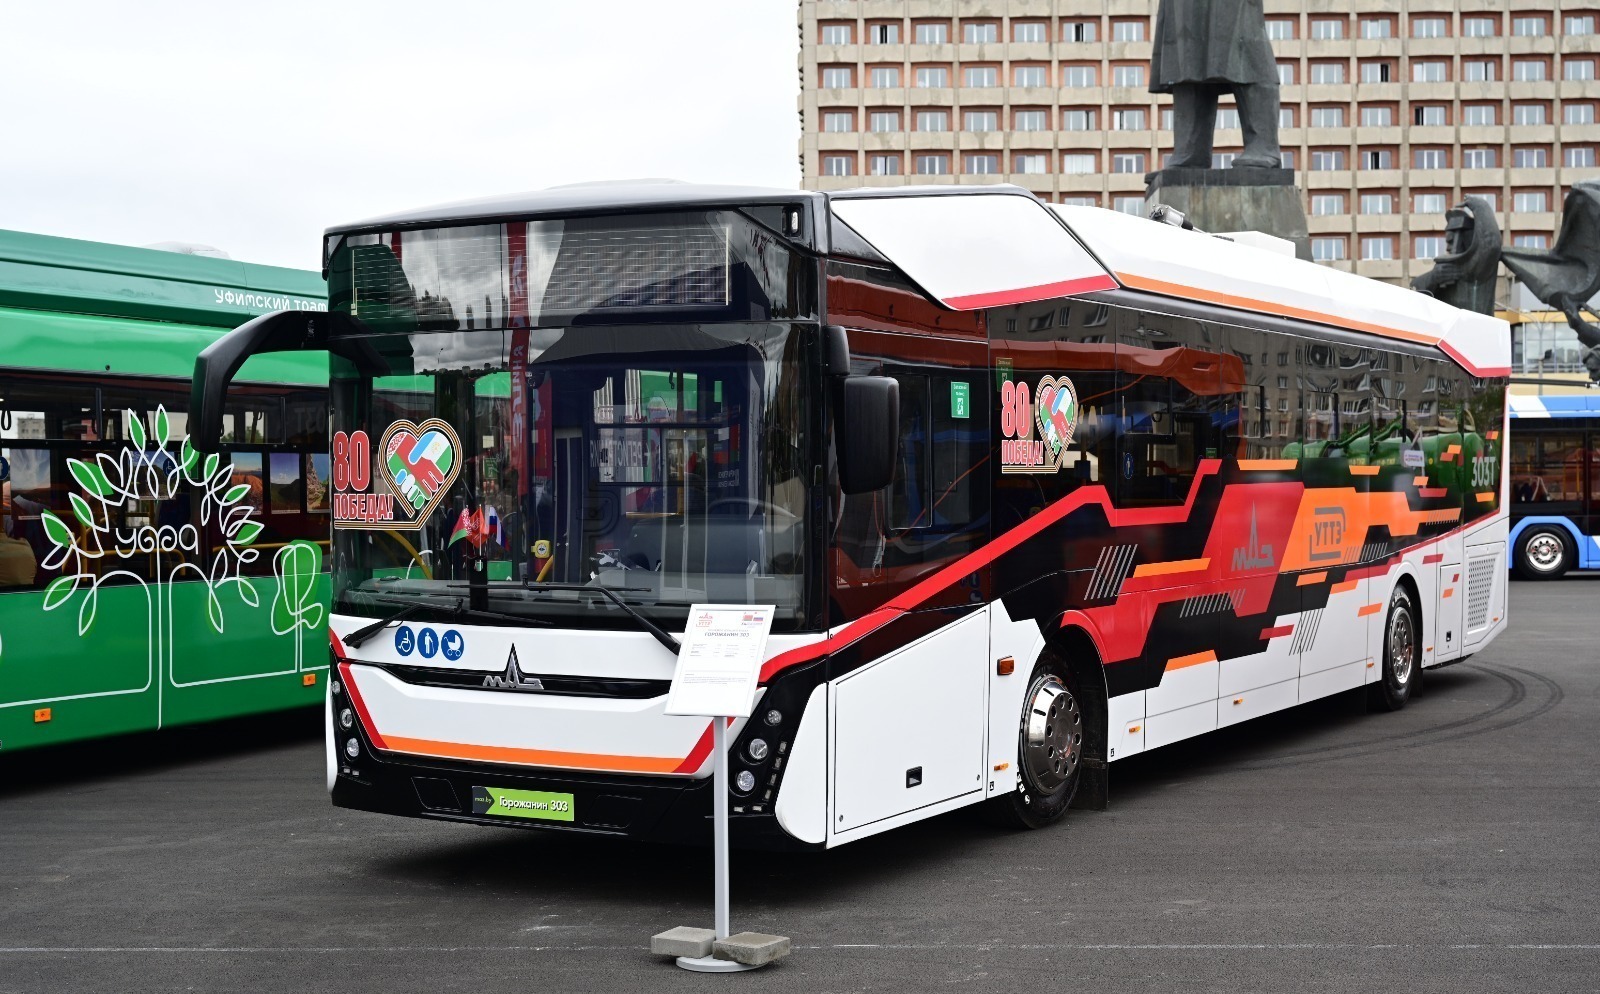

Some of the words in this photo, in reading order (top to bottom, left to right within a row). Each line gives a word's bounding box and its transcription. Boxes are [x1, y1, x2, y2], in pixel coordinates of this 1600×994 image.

[214, 288, 291, 310] Уфимский
[1001, 379, 1030, 438] 80
[333, 430, 370, 491] 80
[1001, 439, 1044, 467] ПОБЕДА!
[333, 493, 394, 523] ПОБЕДА!
[499, 795, 549, 810] Горожанин
[550, 799, 569, 812] 303
